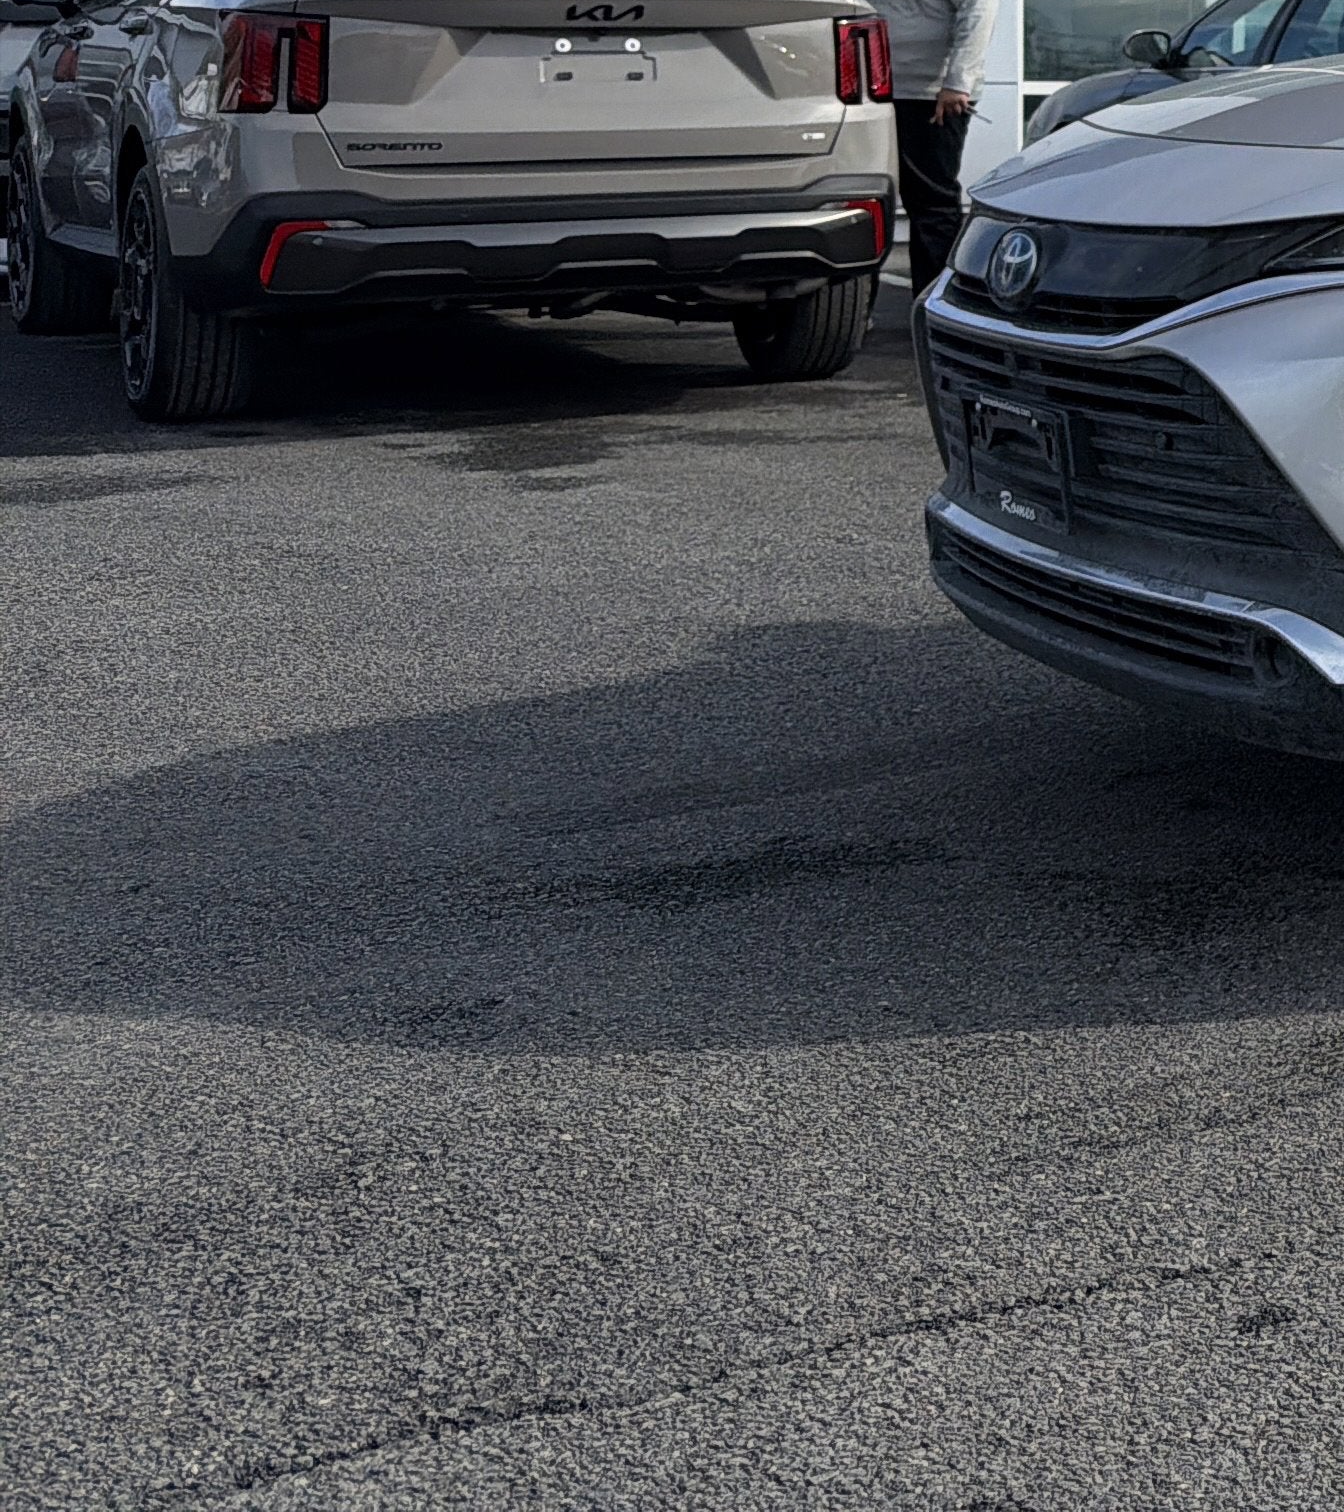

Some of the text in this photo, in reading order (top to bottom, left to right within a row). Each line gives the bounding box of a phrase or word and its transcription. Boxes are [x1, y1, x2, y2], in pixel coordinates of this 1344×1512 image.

[566, 4, 645, 21] KIA
[347, 142, 443, 151] SORENTO
[1000, 490, 1036, 521] Romeo
